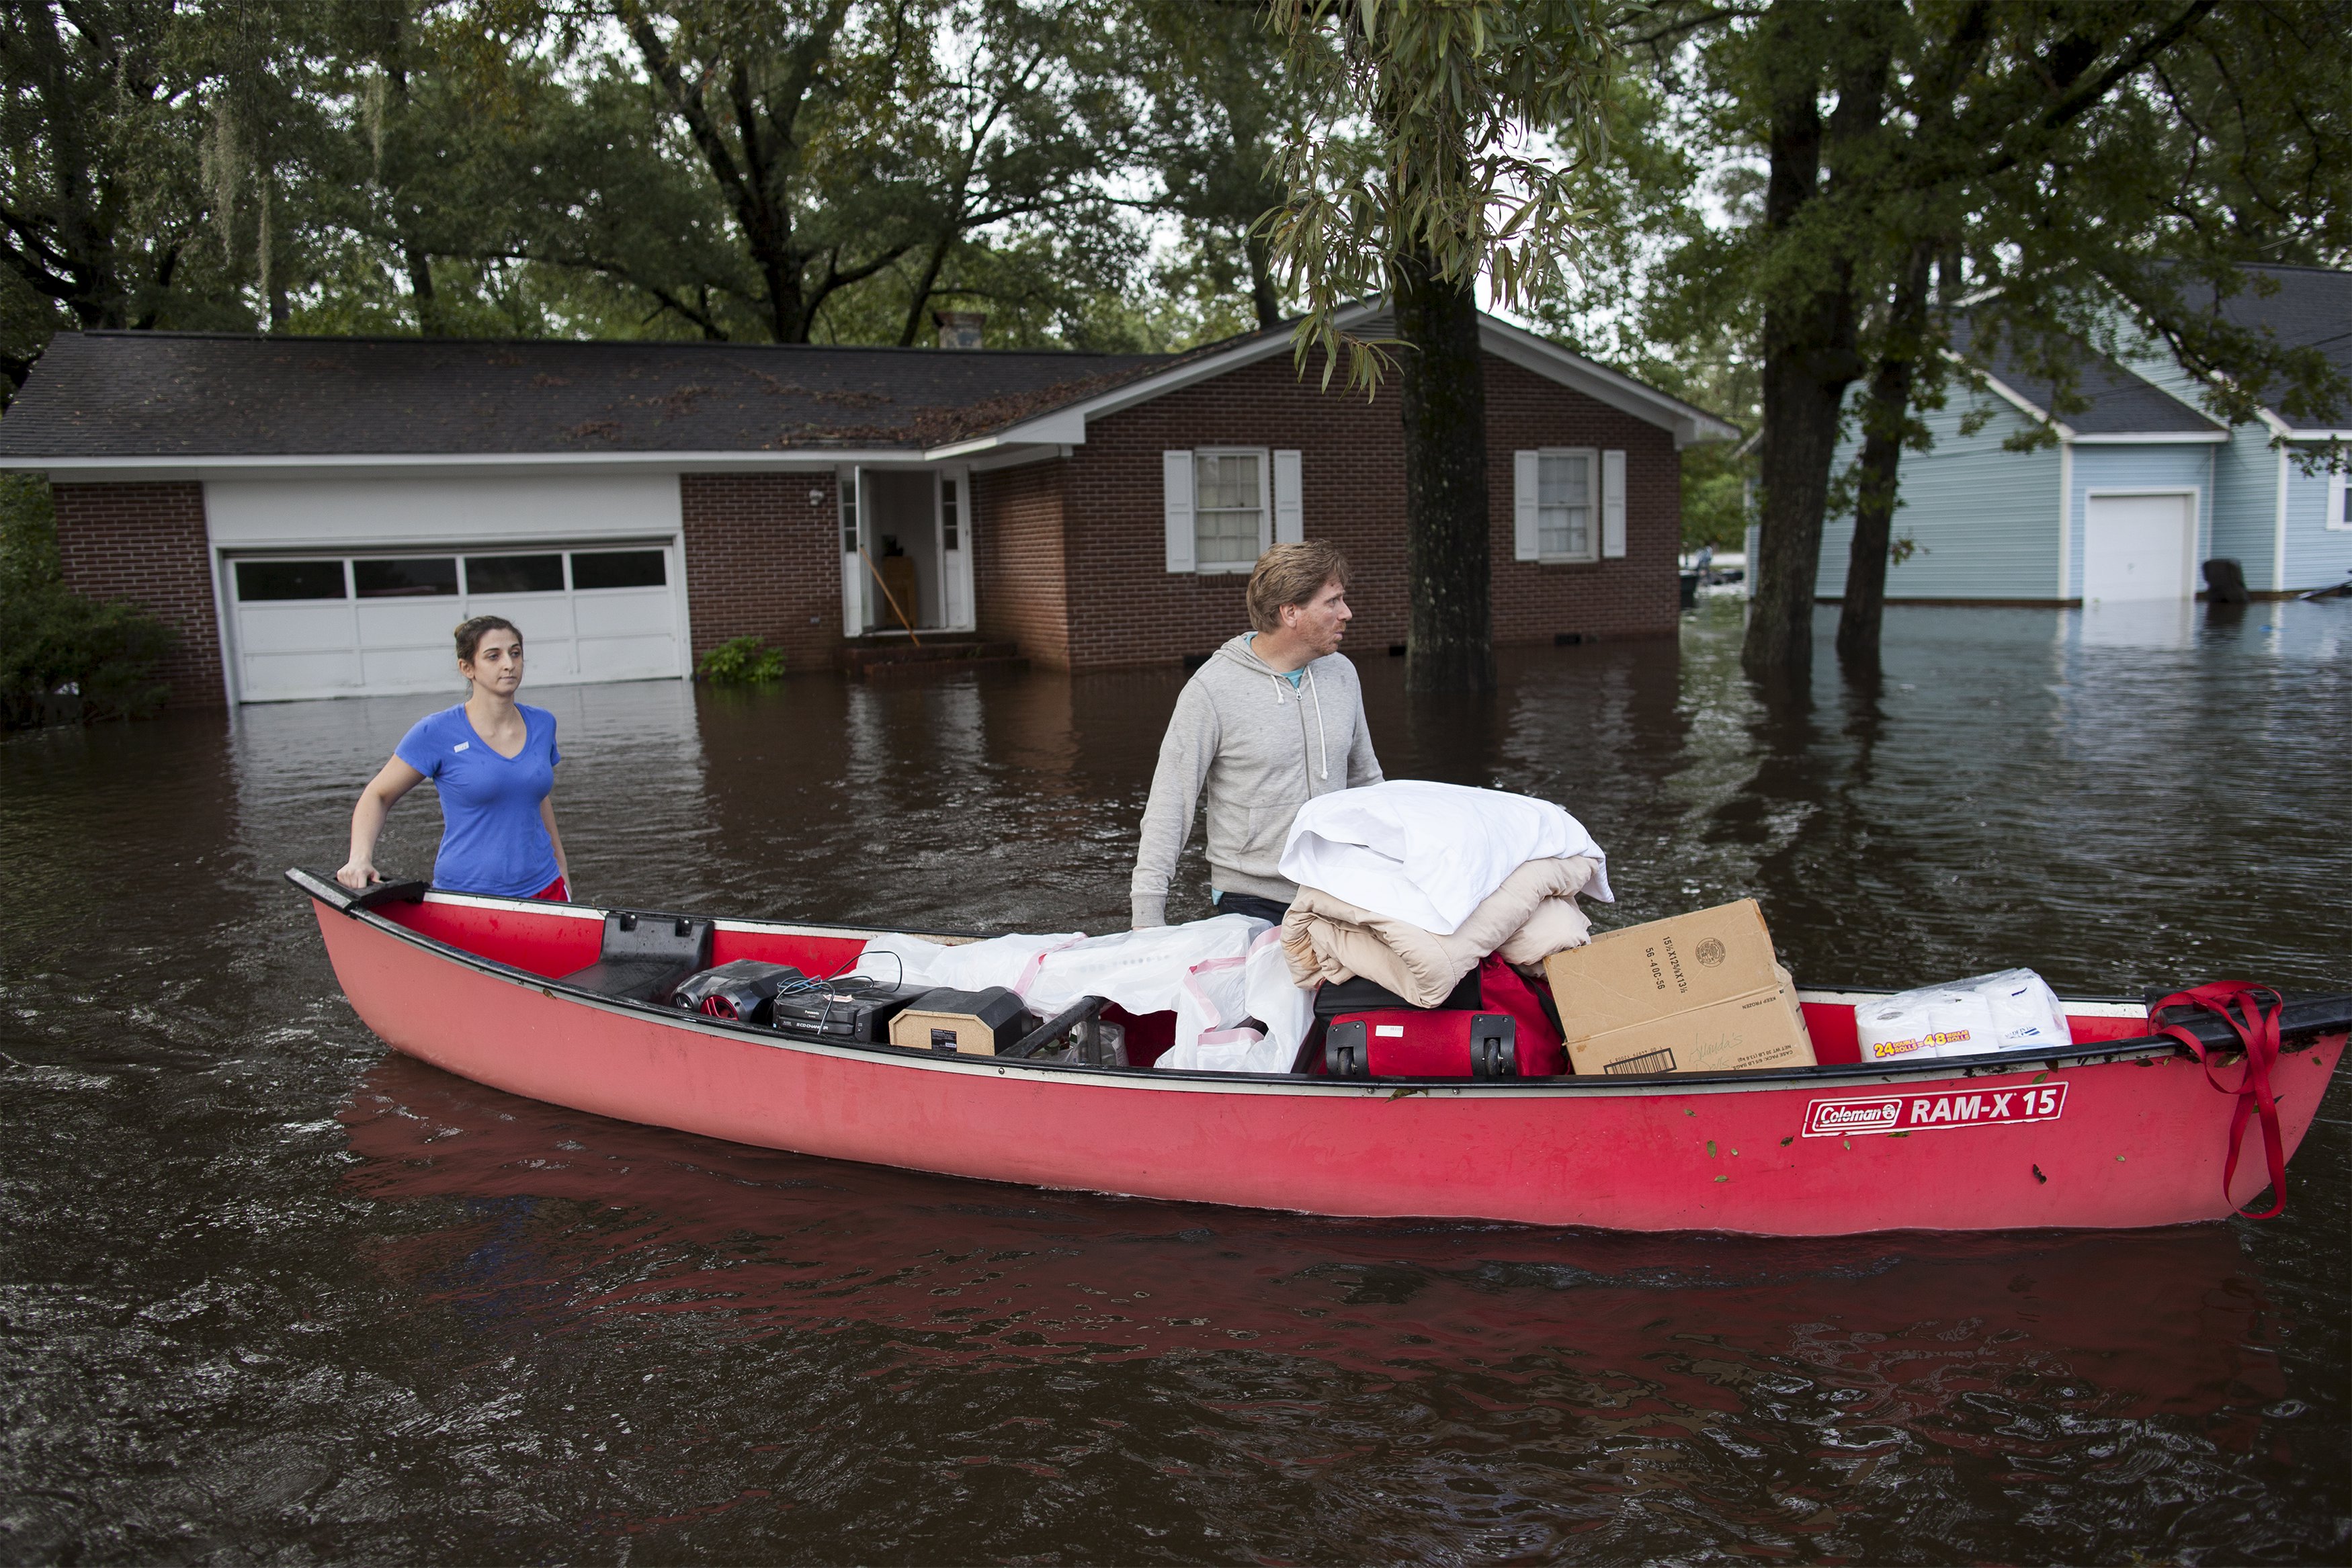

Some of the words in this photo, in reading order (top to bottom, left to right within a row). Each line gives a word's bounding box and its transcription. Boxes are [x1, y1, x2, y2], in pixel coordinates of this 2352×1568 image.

[1742, 1000, 1762, 1009] FROZEN
[1894, 1039, 1916, 1047] DOUBLE
[1923, 1033, 1947, 1047] 48
[1947, 1035, 1970, 1043] ROLLS
[1874, 1041, 1895, 1058] 24
[1895, 1044, 1918, 1053] ROLLS
[1779, 1050, 1793, 1058] CASE
[1820, 1106, 1882, 1124] Coleman
[1910, 1093, 2013, 1123] RAM-X
[2023, 1089, 2057, 1115] 15
